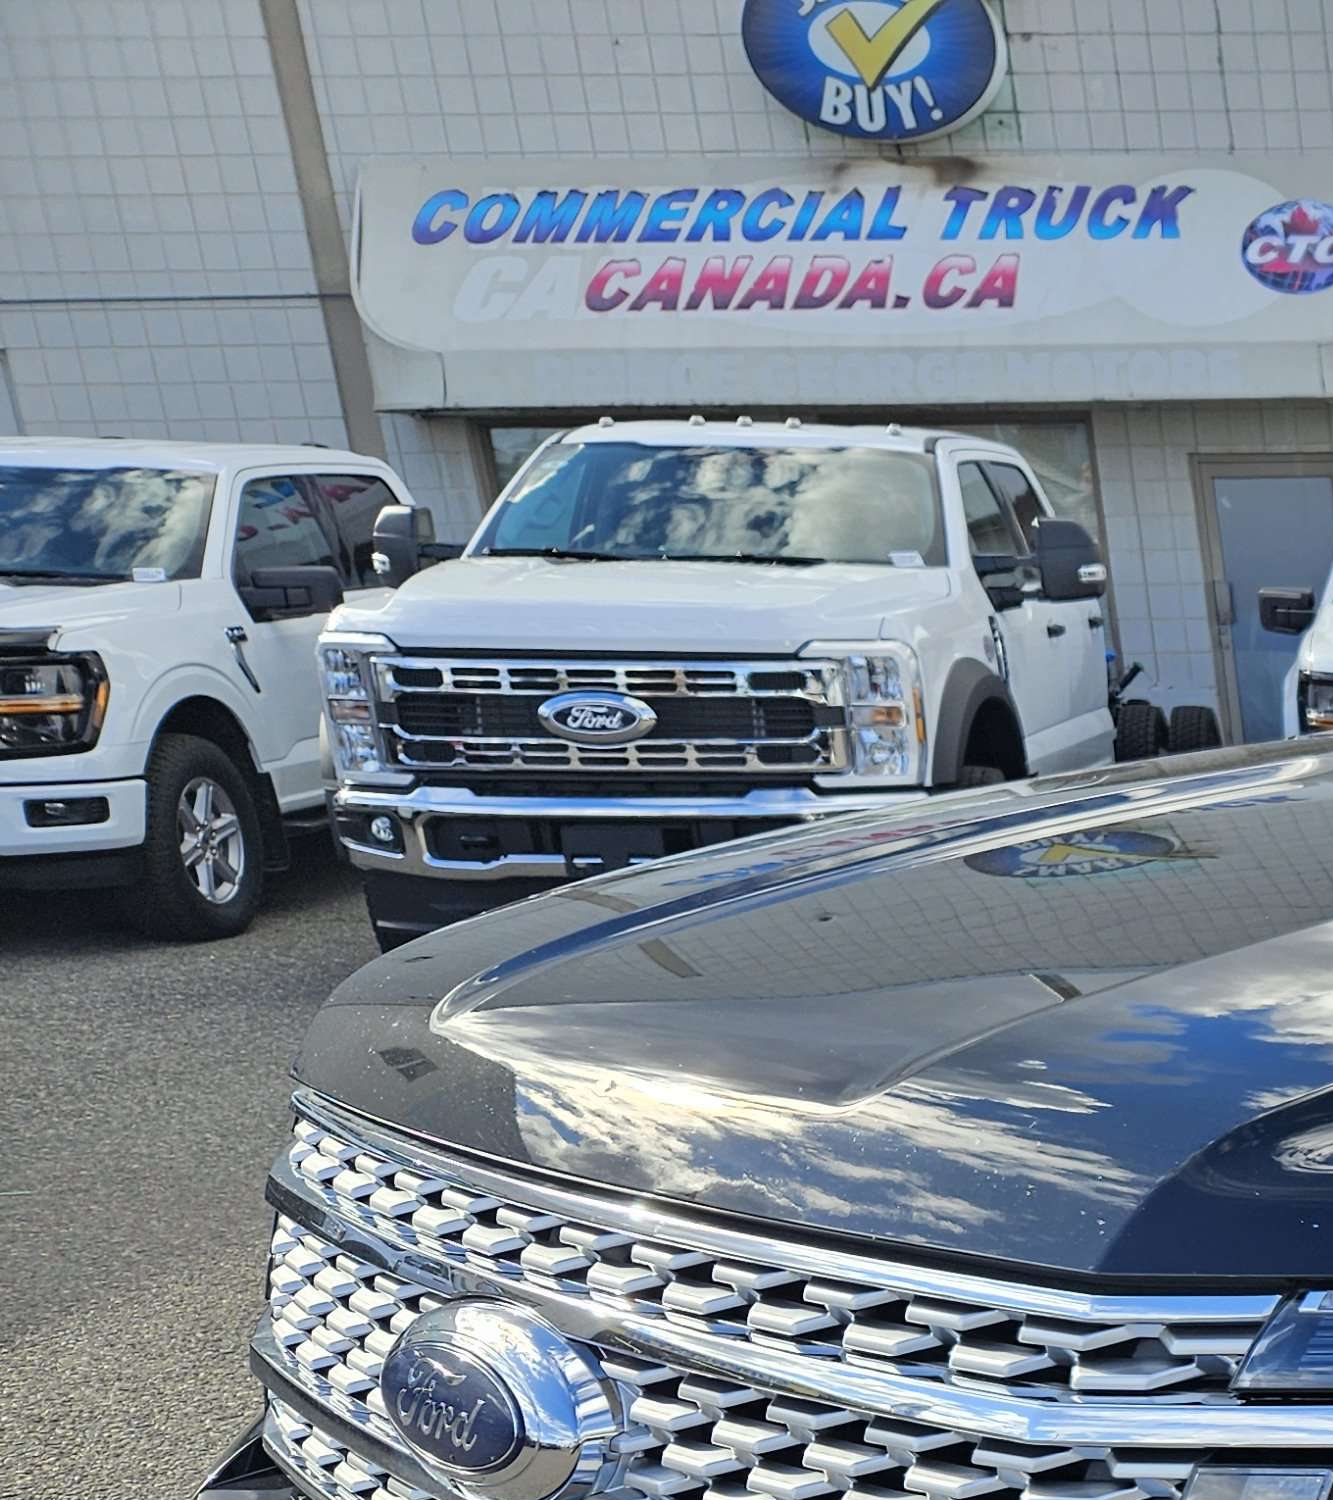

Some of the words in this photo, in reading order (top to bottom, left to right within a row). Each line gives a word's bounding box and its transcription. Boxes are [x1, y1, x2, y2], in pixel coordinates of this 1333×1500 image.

[819, 75, 943, 133] BUY!
[411, 184, 907, 246] COMMERCIAL
[940, 184, 1196, 242] TRUCK
[584, 252, 1021, 313] CANADA.CA
[566, 705, 624, 730] Ford
[396, 1350, 487, 1452] Ford
